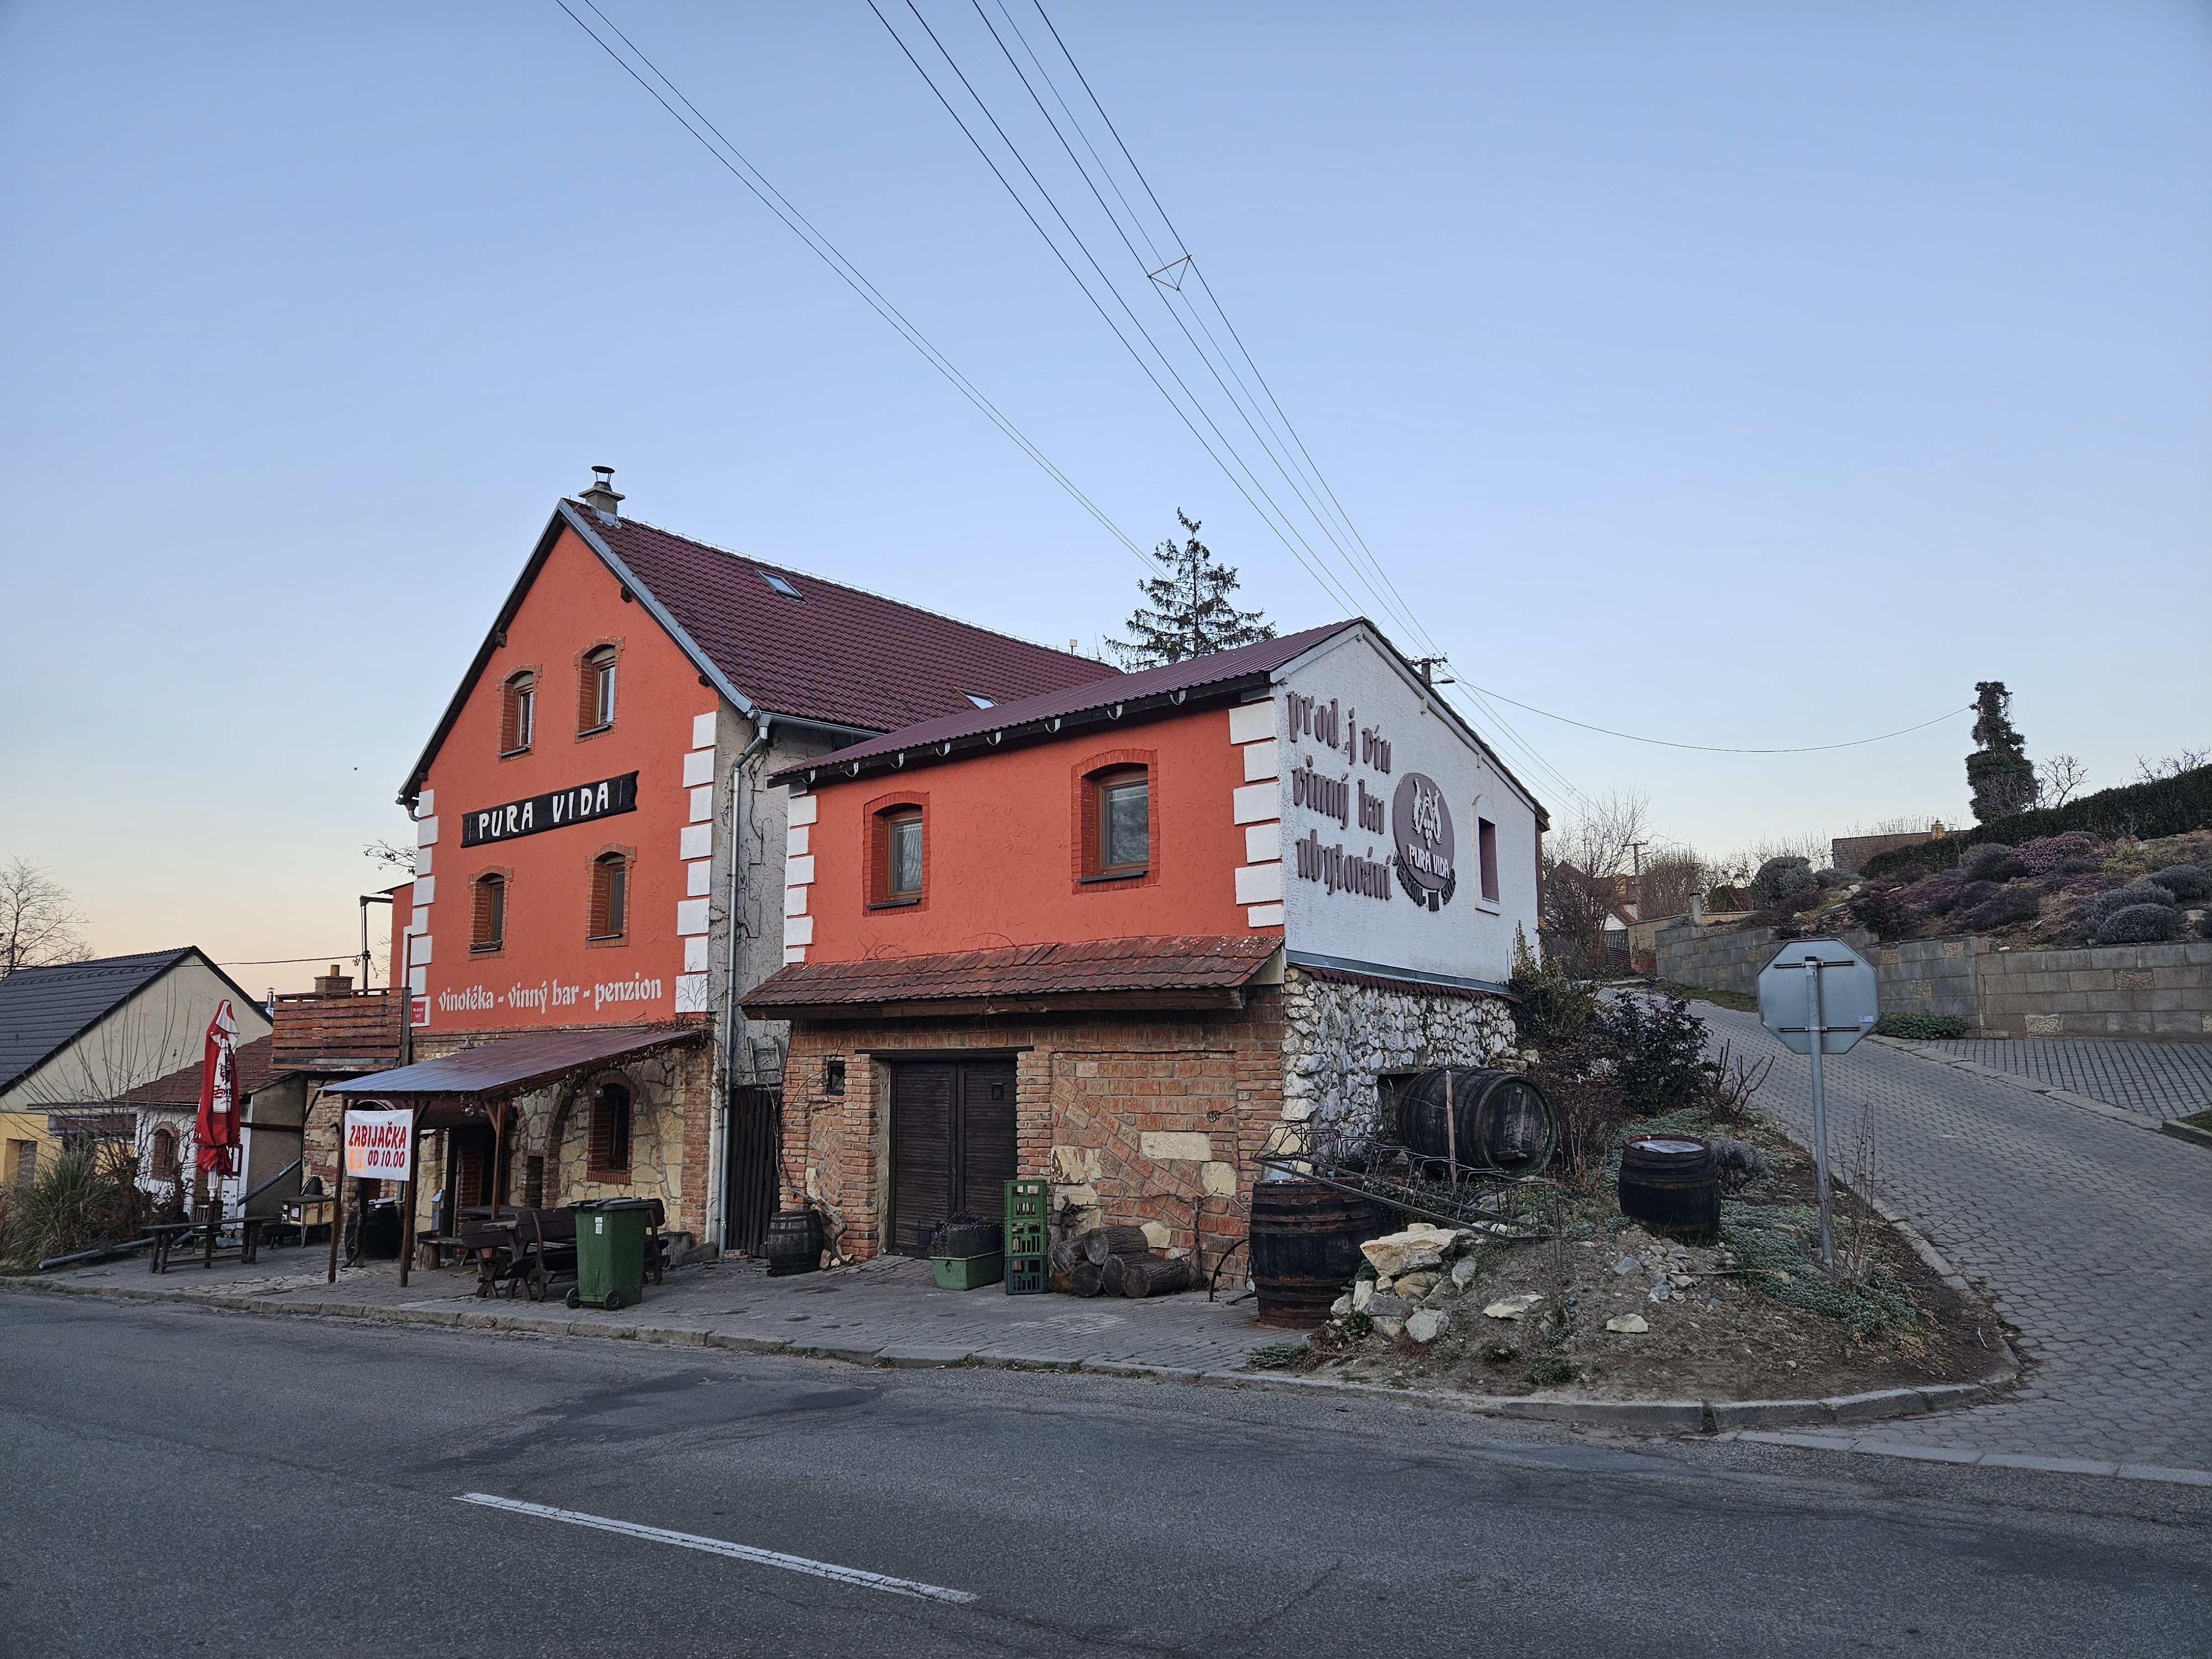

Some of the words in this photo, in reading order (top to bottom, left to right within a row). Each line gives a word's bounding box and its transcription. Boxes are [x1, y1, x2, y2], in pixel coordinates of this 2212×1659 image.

[478, 801, 533, 839] PURA
[552, 781, 609, 823] VIDA
[1291, 755, 1349, 830] vinný
[1357, 779, 1385, 834] bar
[1406, 843, 1431, 873] PURA
[1431, 853, 1450, 879] VIDA
[439, 984, 494, 1012] vinotéka
[508, 980, 547, 1014] vinný
[551, 979, 579, 1006] bar
[594, 972, 662, 1011] penzion
[349, 1121, 406, 1150] ZABIJAČKA
[368, 1149, 379, 1167] OD
[380, 1150, 405, 1168] 10.00
